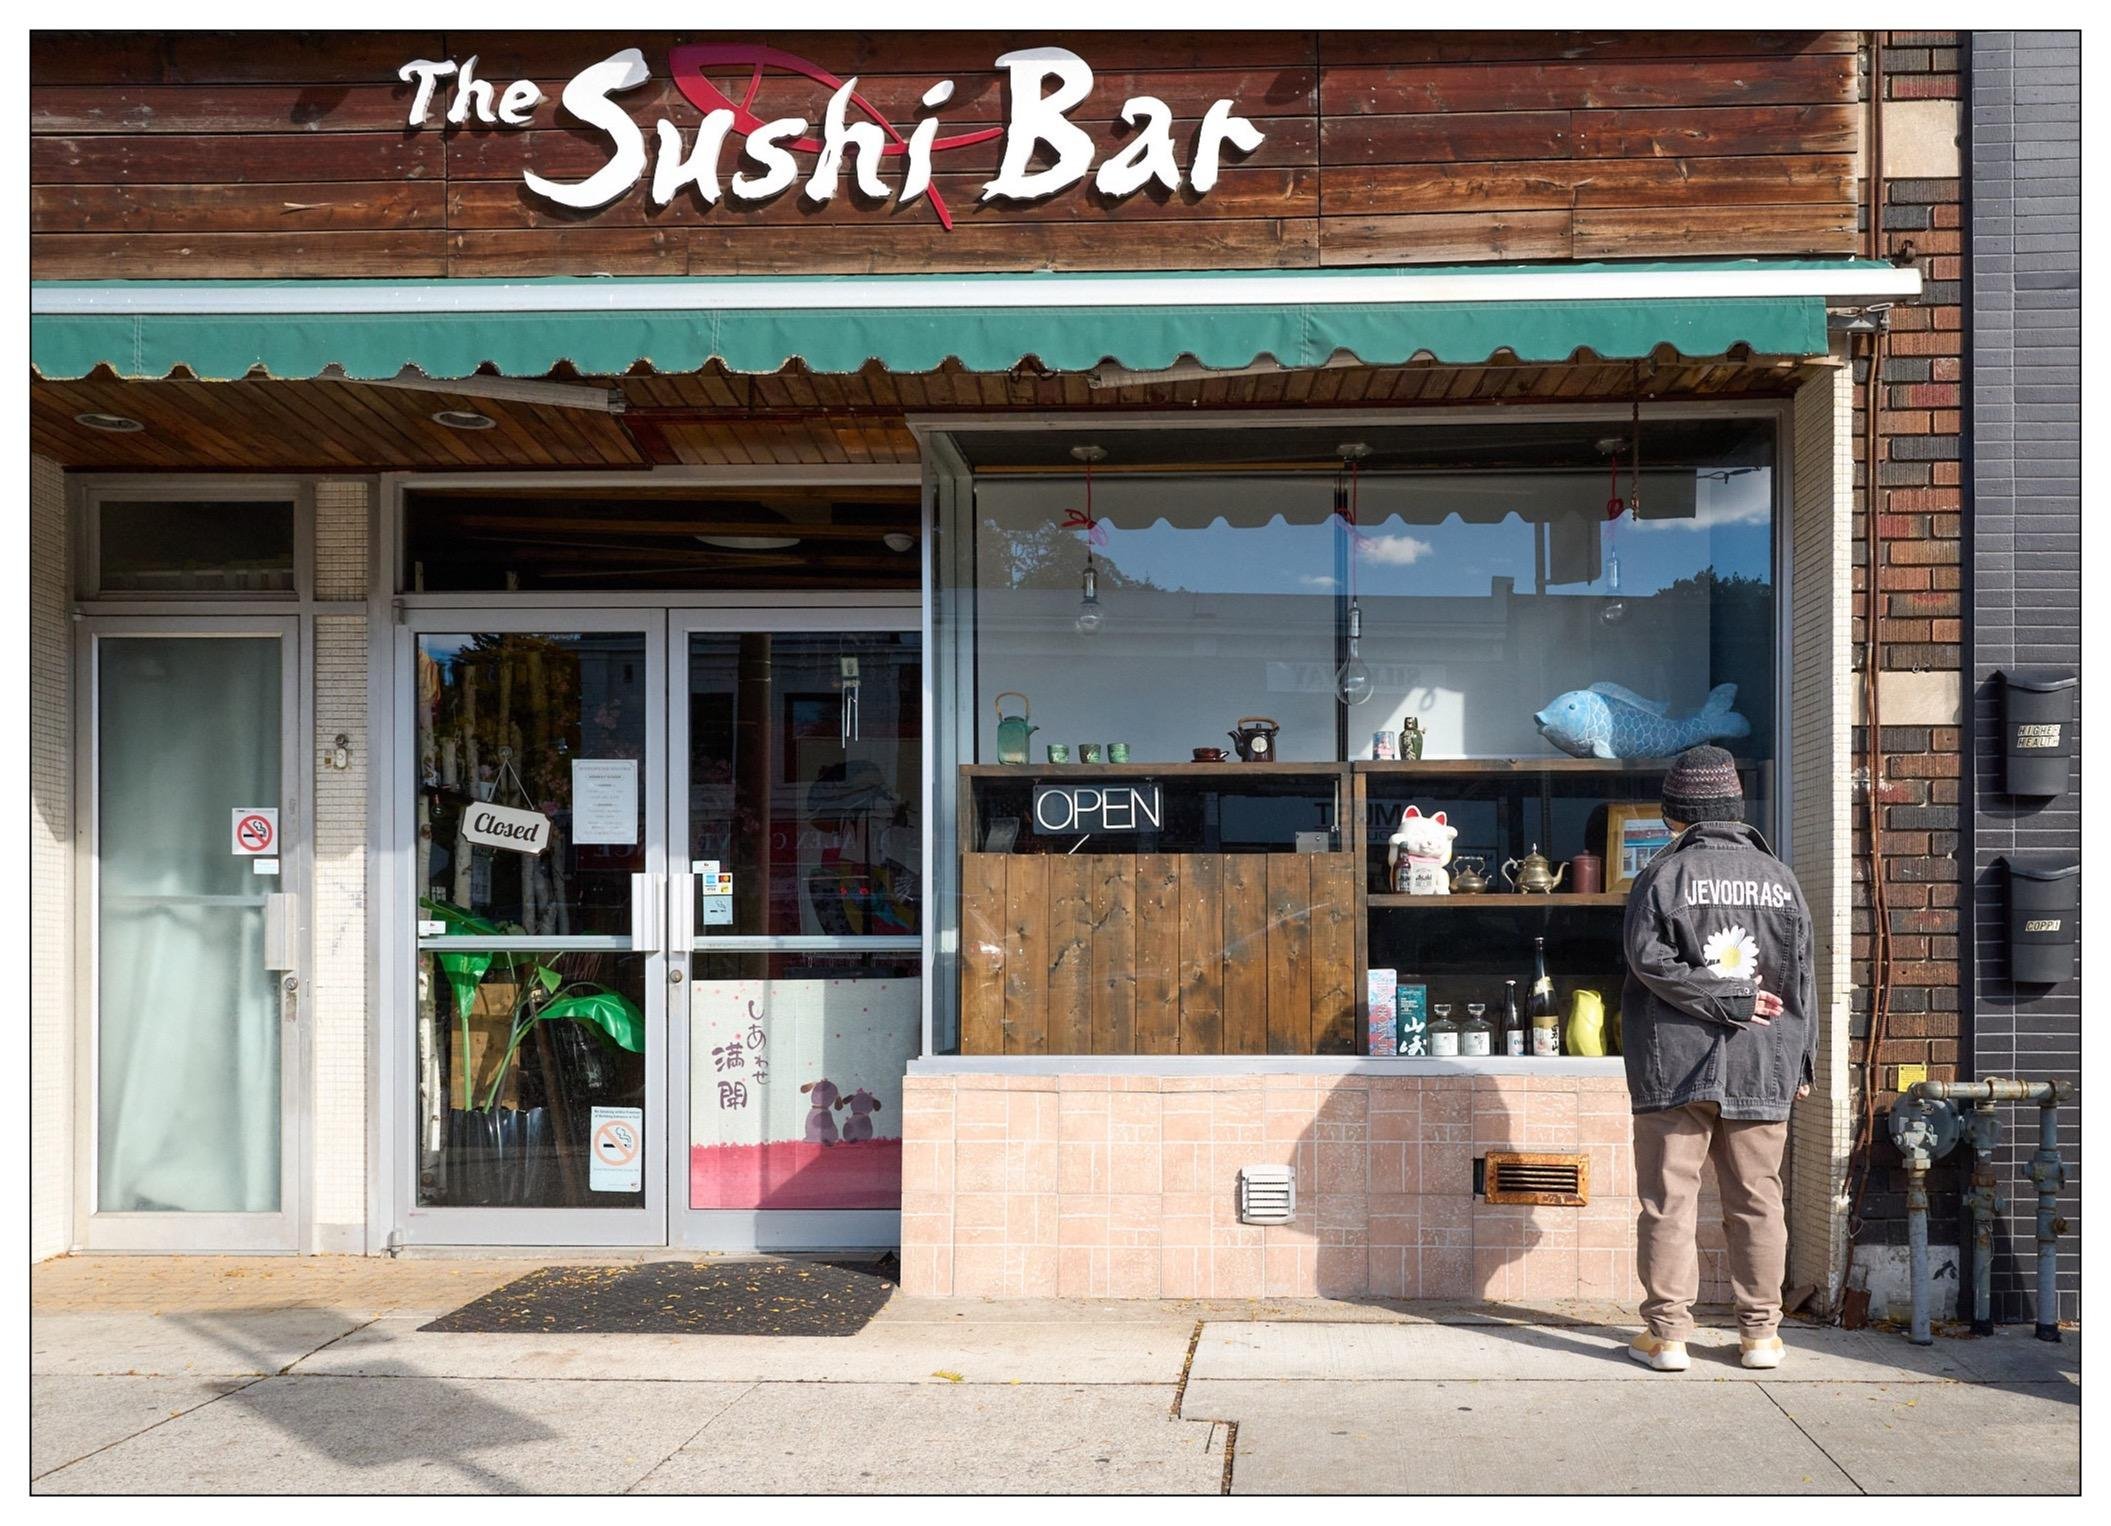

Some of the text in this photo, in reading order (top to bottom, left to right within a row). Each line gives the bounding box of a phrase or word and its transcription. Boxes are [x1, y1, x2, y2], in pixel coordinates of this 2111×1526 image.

[399, 46, 1266, 208] The Sushi Bar
[474, 812, 540, 842] Closed
[1037, 787, 1160, 830] OPEN
[747, 1000, 771, 1085] しあわせ
